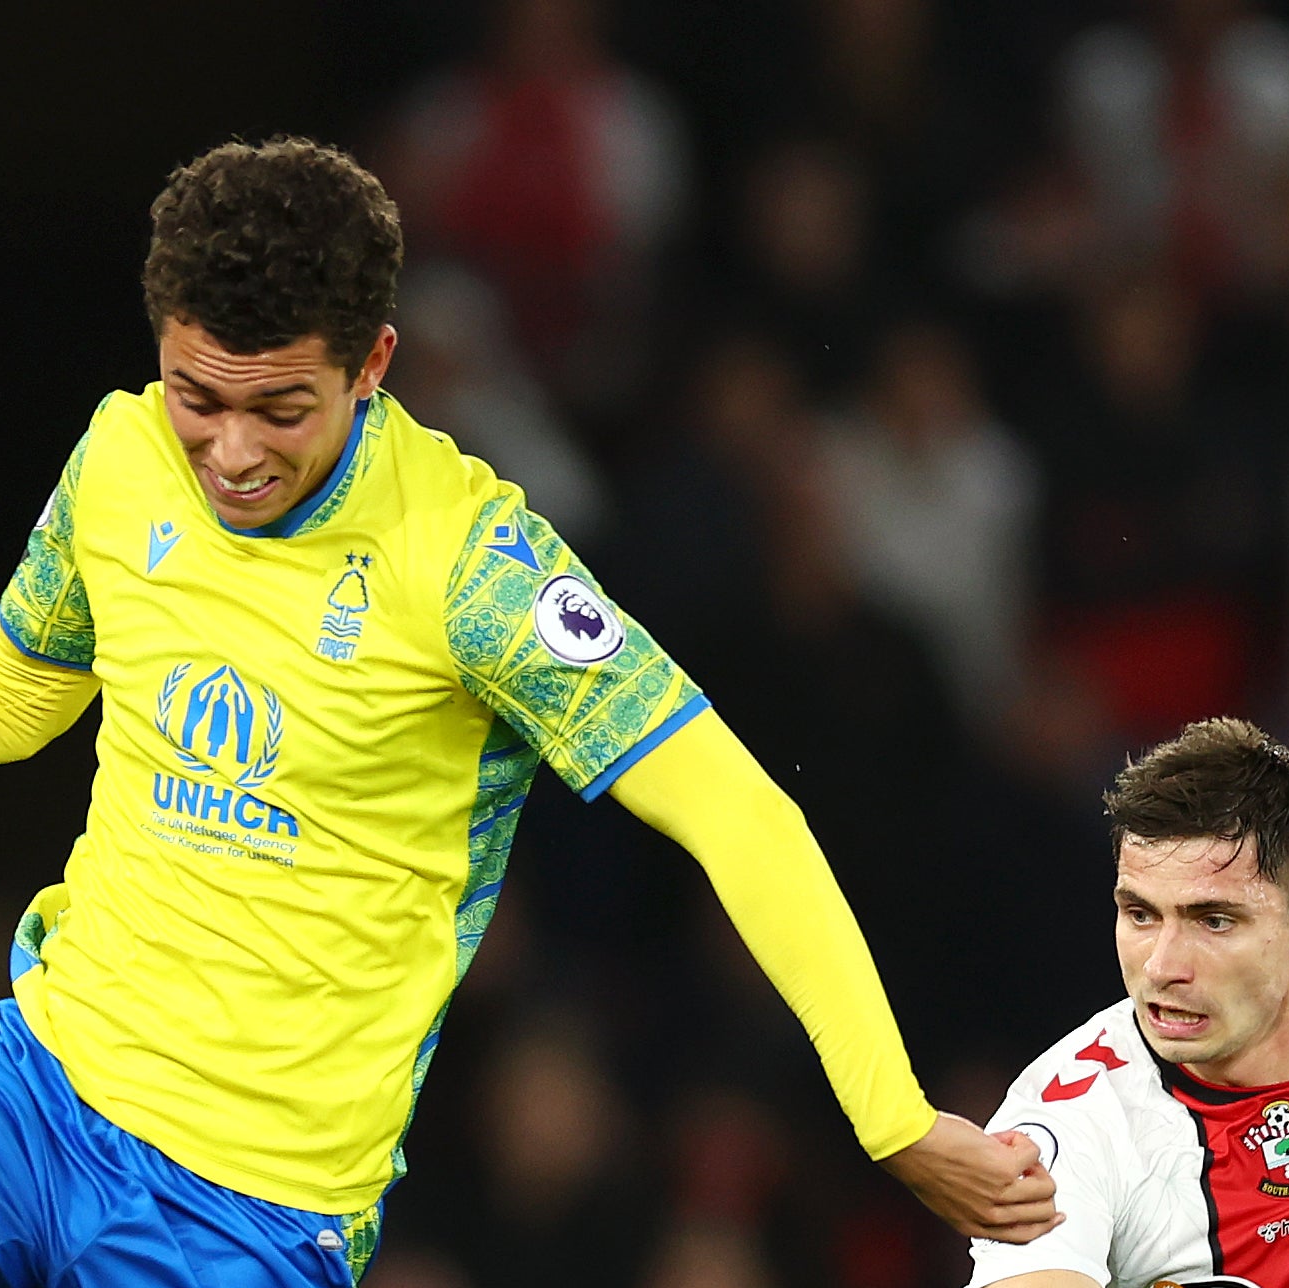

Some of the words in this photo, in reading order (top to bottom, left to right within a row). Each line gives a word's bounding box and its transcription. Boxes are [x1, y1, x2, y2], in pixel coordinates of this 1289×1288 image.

[152, 772, 299, 837] UNHCR
[152, 811, 165, 826] The
[168, 817, 183, 831] UN
[185, 821, 237, 842] Refugee
[243, 833, 298, 854] Agency
[227, 845, 246, 858] for
